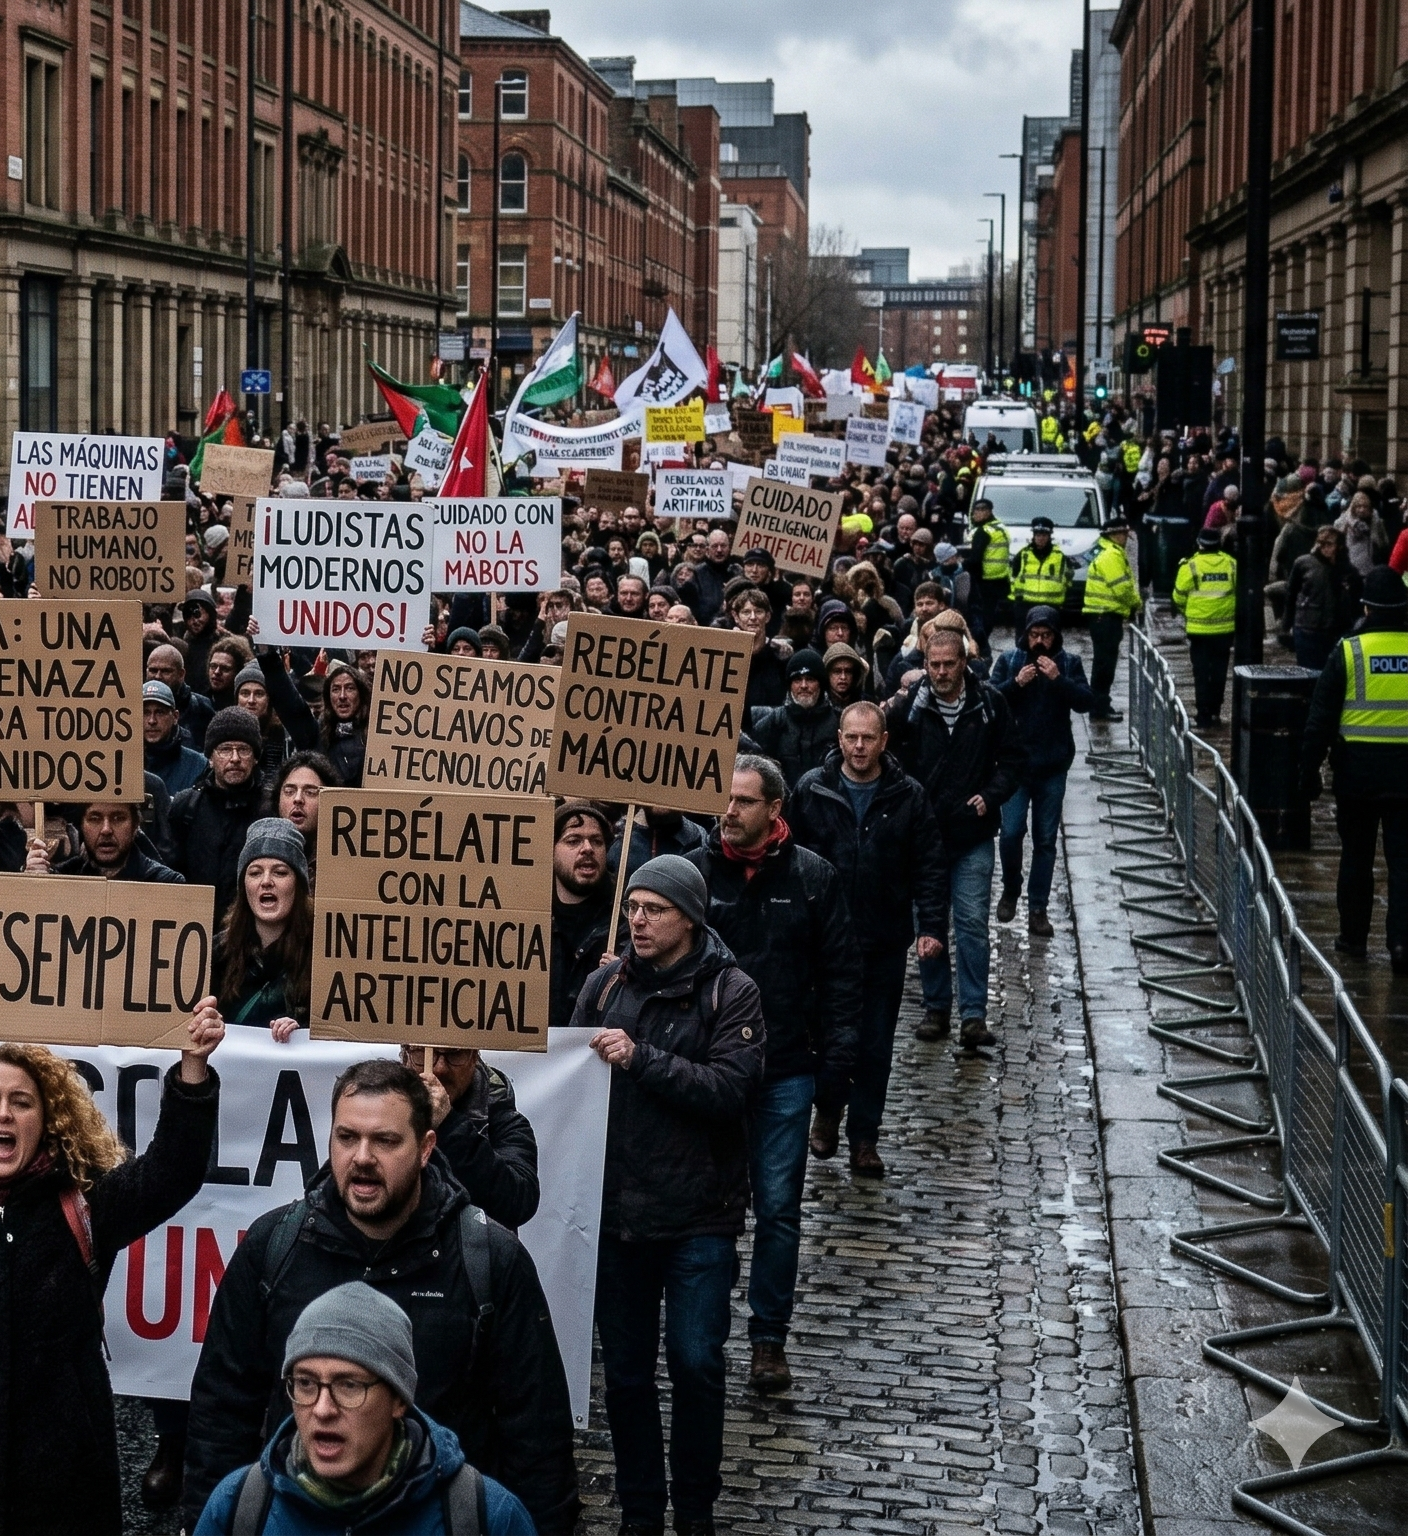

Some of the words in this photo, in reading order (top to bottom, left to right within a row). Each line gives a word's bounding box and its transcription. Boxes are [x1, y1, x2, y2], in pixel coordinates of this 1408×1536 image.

[16, 440, 53, 466] LAS
[59, 437, 159, 472] MÁQUINAS
[24, 471, 57, 497] NO
[65, 473, 144, 500] TIENEN
[750, 485, 832, 521] CUIDADO
[50, 504, 159, 531] TRABAJO
[263, 506, 425, 550] ¡LUDISTAS
[434, 503, 507, 525] UIDADO
[514, 503, 554, 525] CON
[745, 511, 827, 543] INTELIGENCIA
[56, 534, 164, 563] HUMANO,
[456, 530, 487, 554] NO
[496, 530, 524, 554] LA
[739, 531, 823, 568] ARTIFICIAL
[48, 564, 81, 592] NO
[90, 565, 175, 593] ROBOTS
[259, 554, 425, 596] MODERNOS
[40, 611, 121, 651] UNA
[278, 599, 408, 643] UNIDOS!
[571, 630, 745, 695] REBÉLATE
[380, 658, 423, 696] NO
[433, 664, 555, 710] SEAMOS
[36, 706, 132, 743] TODOS
[375, 700, 524, 748] ESCLAVOS
[531, 727, 551, 749] DE
[564, 683, 686, 733] CONTRA
[694, 699, 734, 740] LA
[368, 757, 388, 778] LA
[391, 745, 546, 794] TECNOLOGÍA
[557, 726, 723, 794] MÁQUINA
[330, 796, 536, 868] REBÉLATE
[377, 870, 446, 906] CON
[459, 876, 502, 911] LA
[324, 913, 548, 973] INTELIGENCIA
[321, 971, 540, 1035] ARTIFICIAL
